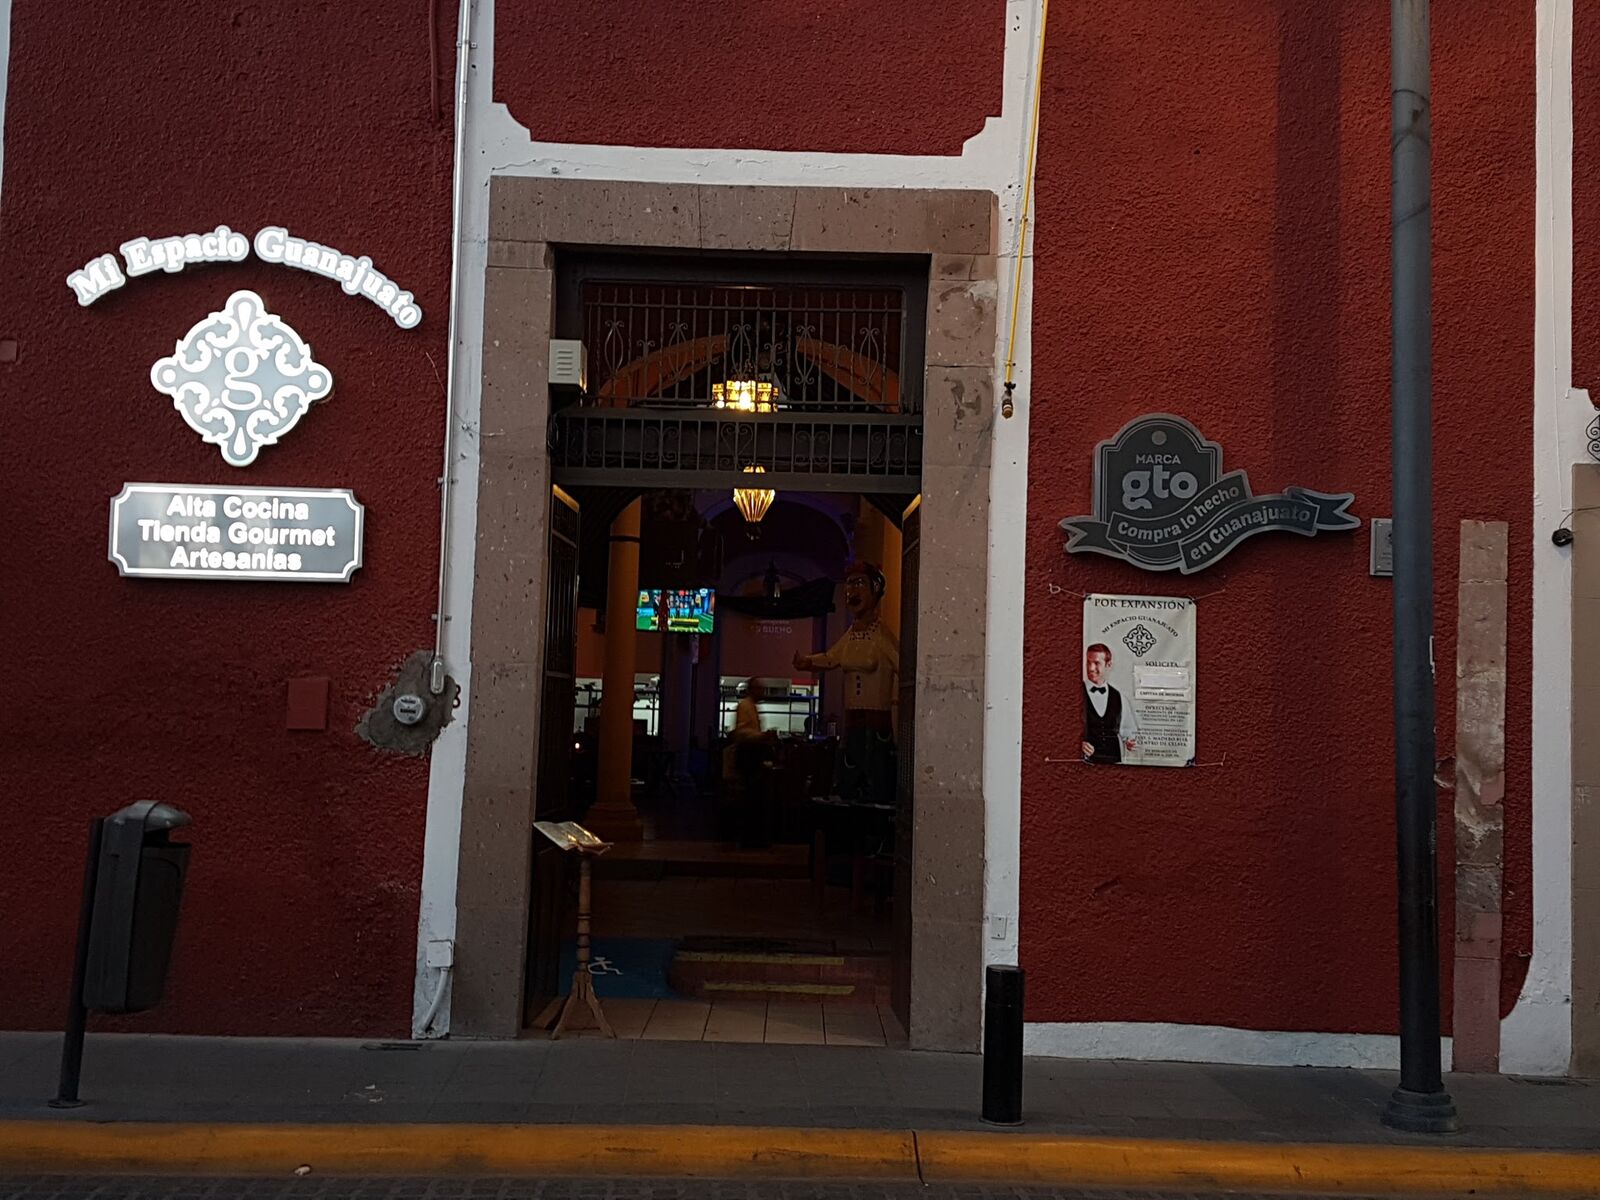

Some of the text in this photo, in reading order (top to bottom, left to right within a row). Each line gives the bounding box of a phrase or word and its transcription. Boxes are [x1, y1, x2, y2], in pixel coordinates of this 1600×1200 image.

[69, 228, 419, 326] Mi Espacio Guanajuato
[1135, 453, 1181, 465] MARCA
[1121, 465, 1199, 510] gto
[166, 494, 310, 521] Alta Cocina
[1117, 485, 1240, 544] Compra lo hecho
[137, 519, 337, 548] Tienda Gourmet
[1190, 504, 1311, 562] en Guanajuato
[1093, 598, 1118, 608] POR
